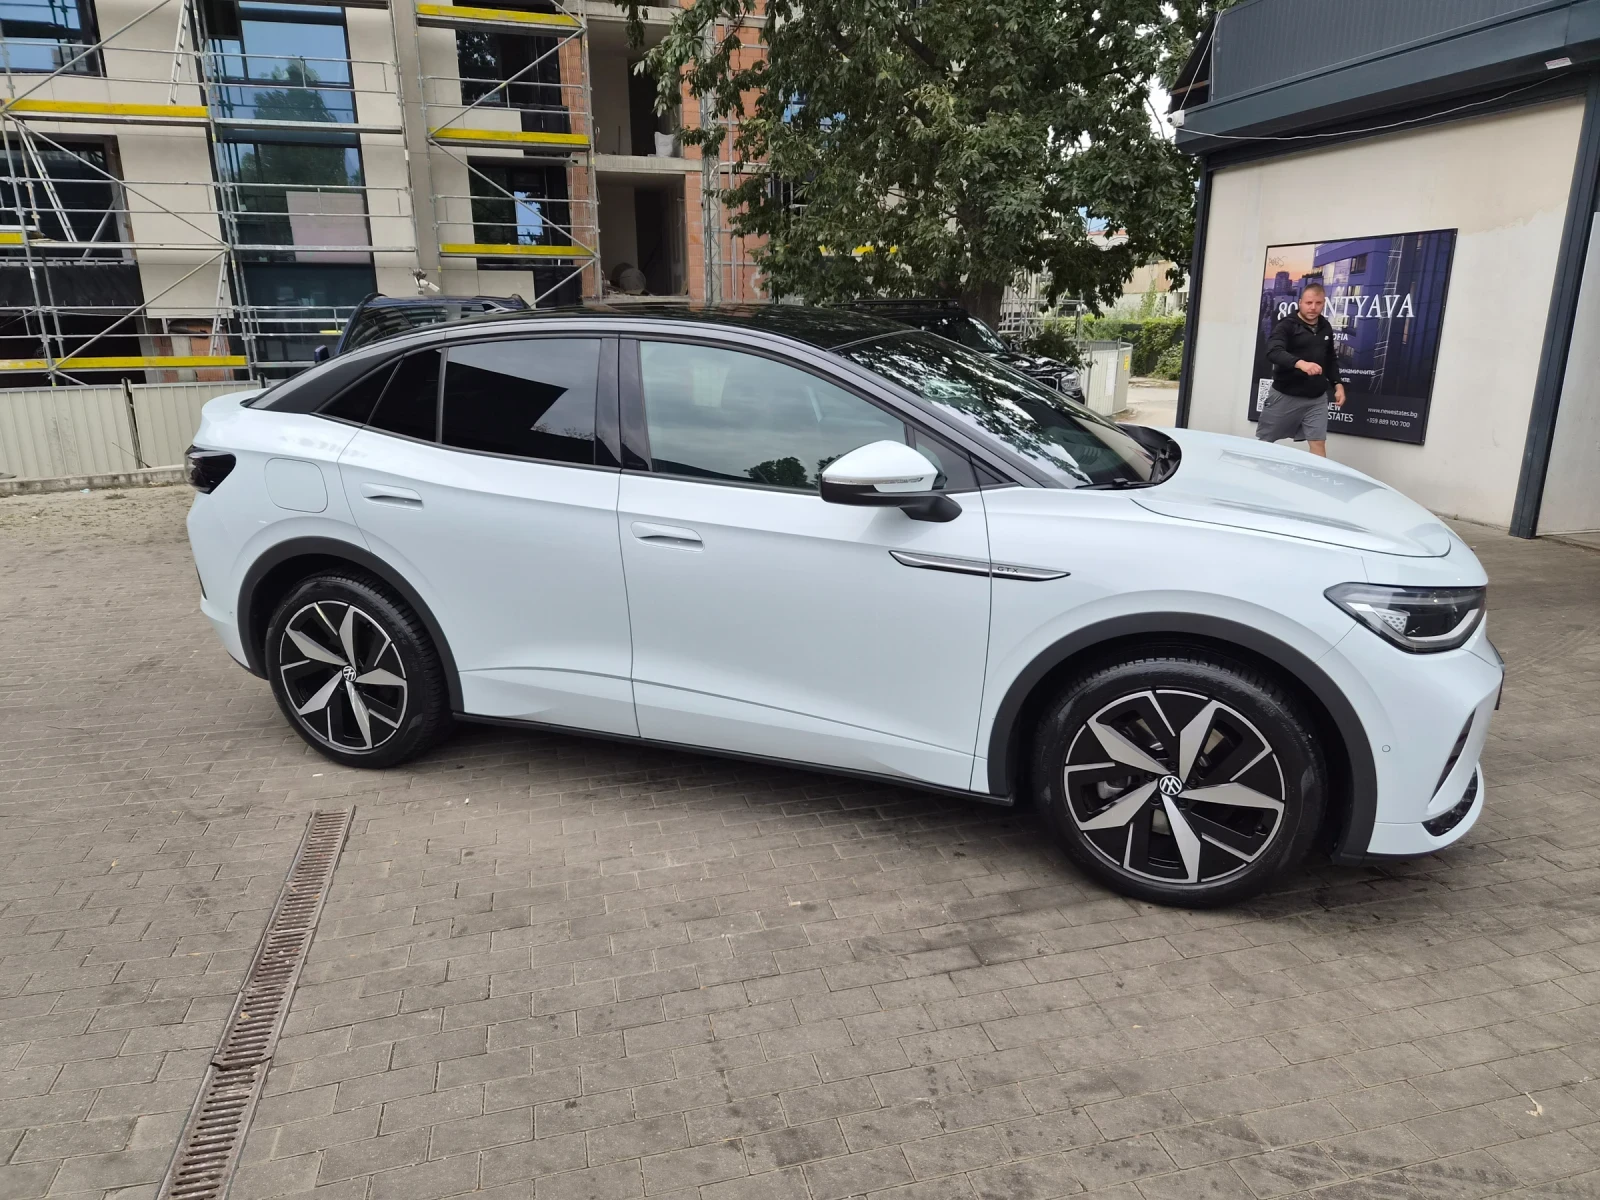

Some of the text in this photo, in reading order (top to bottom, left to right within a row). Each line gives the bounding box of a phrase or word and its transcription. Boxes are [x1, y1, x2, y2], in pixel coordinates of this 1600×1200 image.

[1323, 293, 1415, 318] NTYAVA
[1333, 332, 1348, 341] OFIA
[1327, 411, 1354, 422] STATES
[1367, 408, 1418, 418] www.newestates.bg
[1399, 420, 1411, 428] 700
